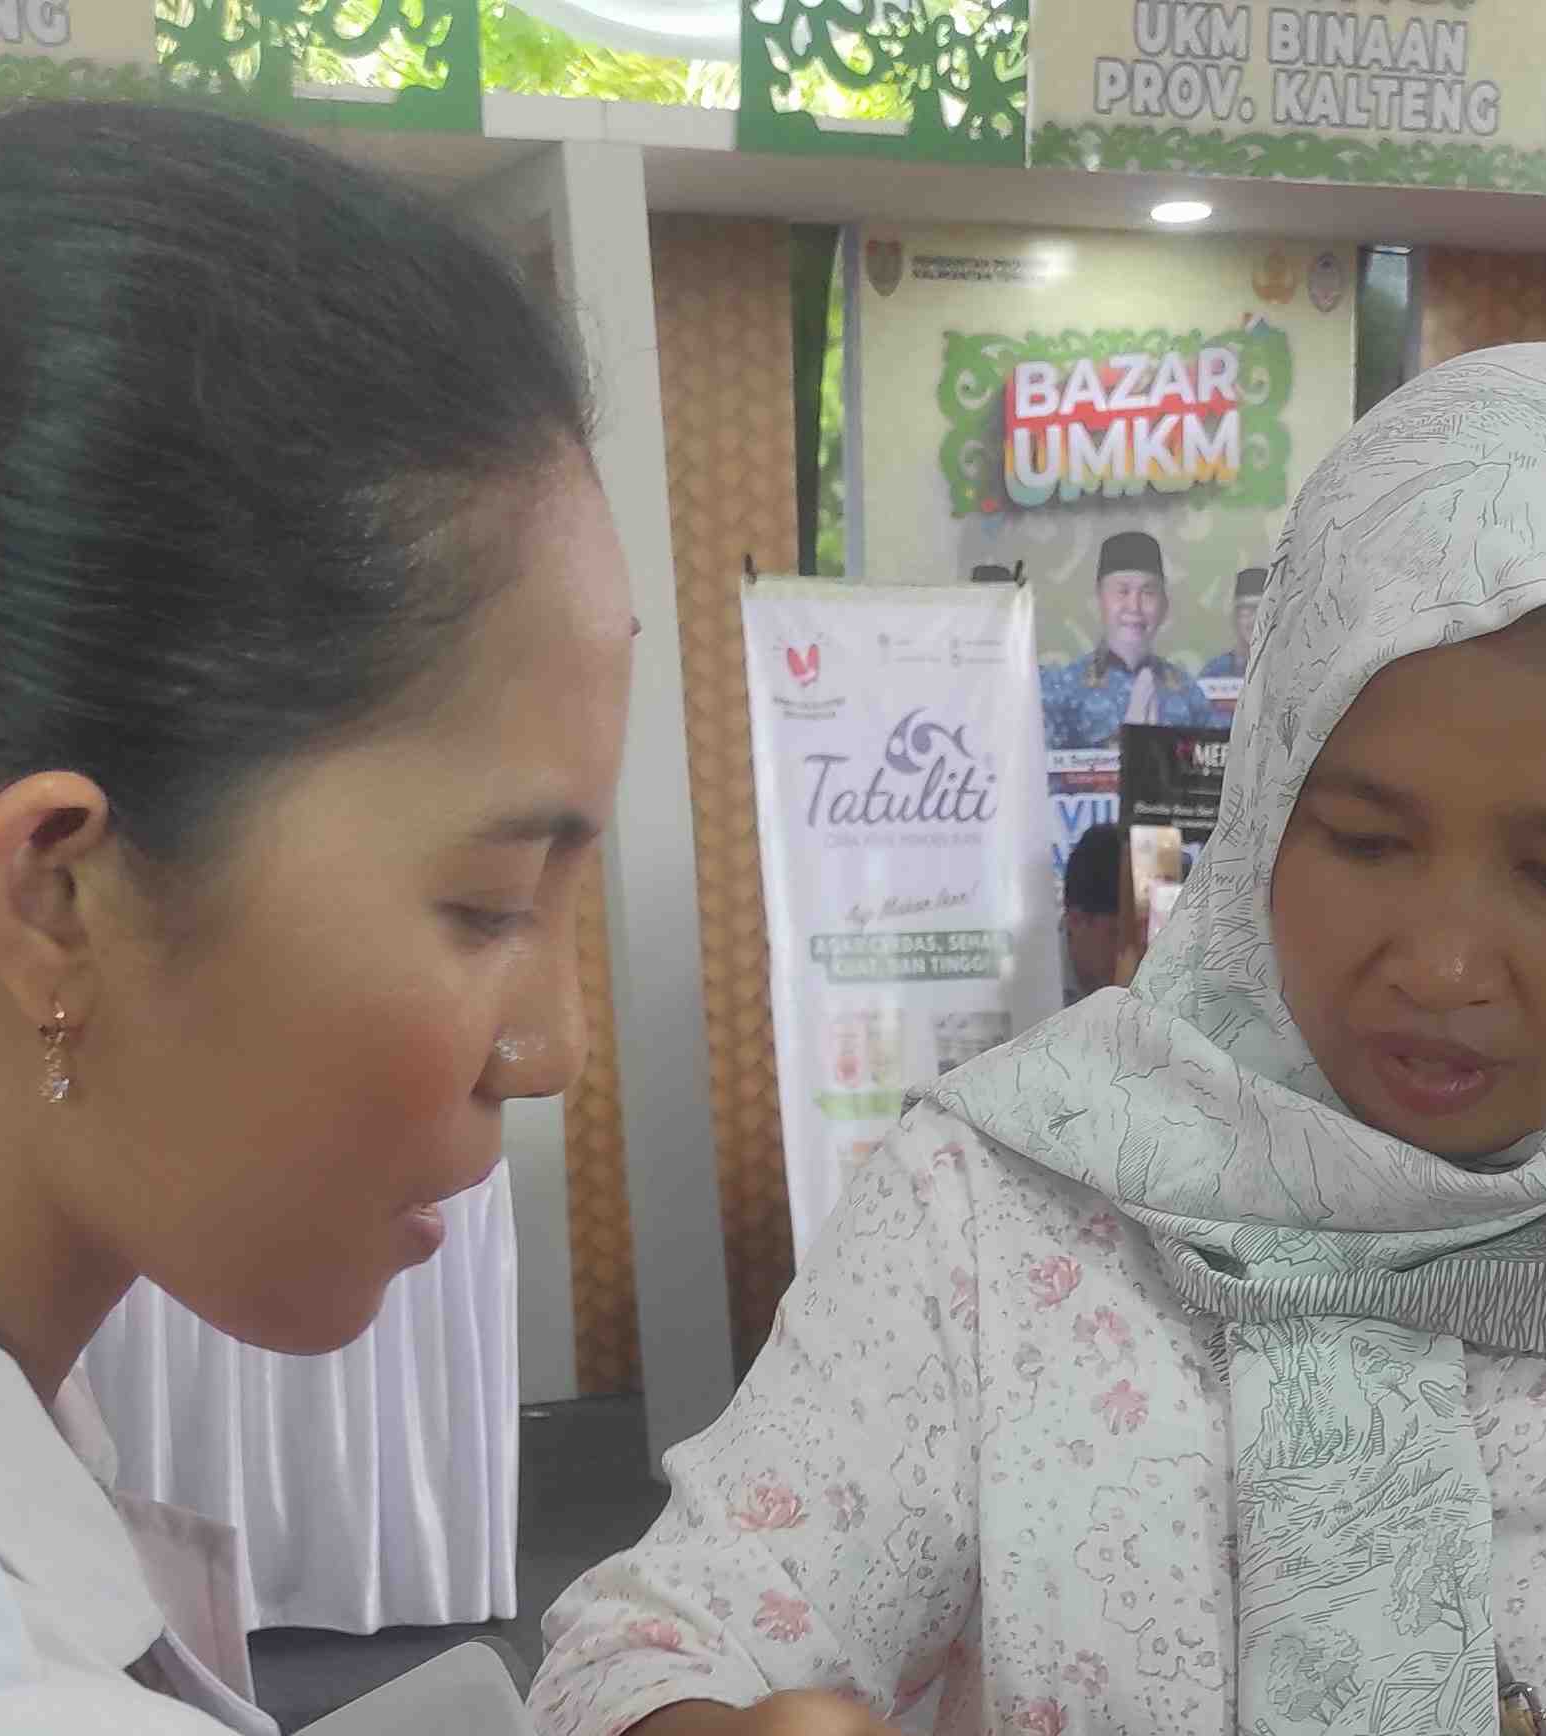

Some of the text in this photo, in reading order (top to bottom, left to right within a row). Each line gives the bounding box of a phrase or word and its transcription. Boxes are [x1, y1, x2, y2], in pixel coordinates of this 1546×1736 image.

[1135, 0, 1467, 75] UKM BINAAN
[1094, 57, 1501, 136] PROV. KALTENG
[1015, 347, 1240, 419] BAZAR
[1013, 409, 1241, 489] UMKM
[804, 754, 998, 828] Tatuliti
